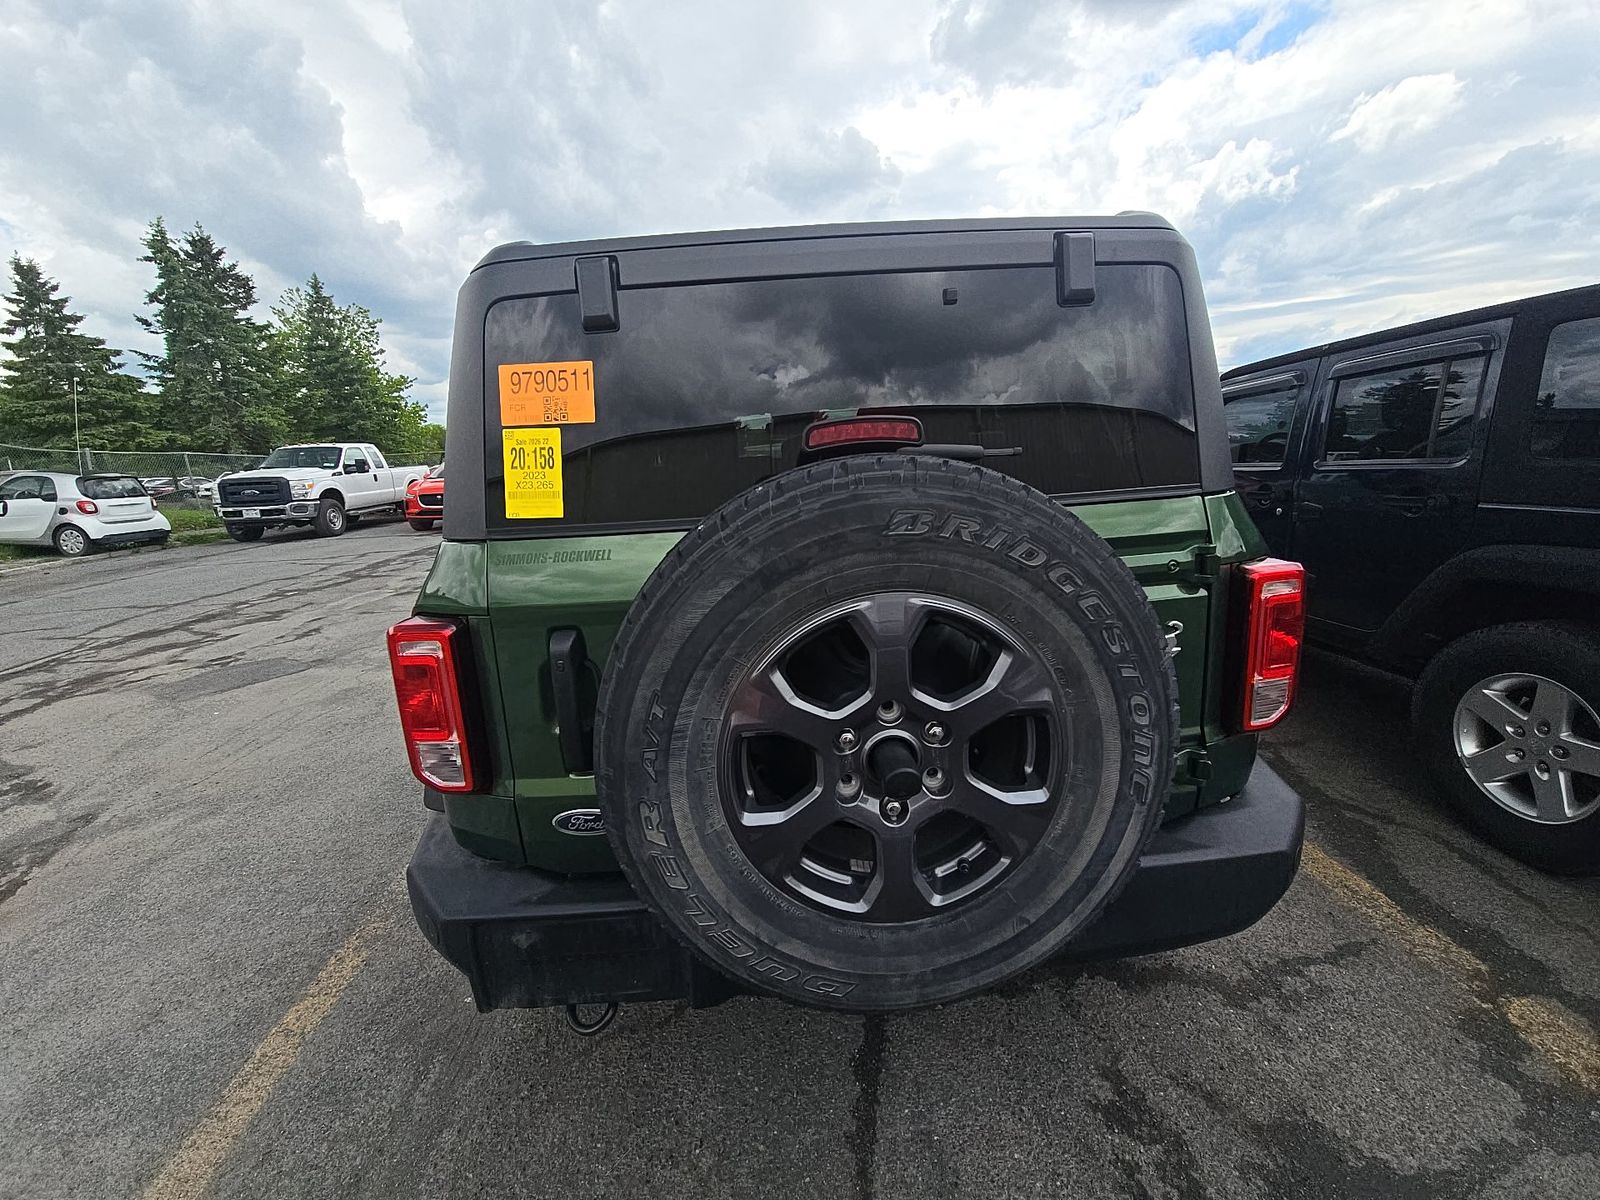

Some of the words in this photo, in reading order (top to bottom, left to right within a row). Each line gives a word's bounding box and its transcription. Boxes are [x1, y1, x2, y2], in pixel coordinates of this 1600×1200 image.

[510, 368, 591, 395] 9790511
[510, 447, 555, 470] 20:158
[522, 471, 546, 480] 2023
[495, 548, 613, 566] SIMMONS-ROCKWELL
[882, 508, 1159, 805] BRIDGESTONE
[568, 815, 606, 830] Ford
[637, 796, 858, 999] DUELER
